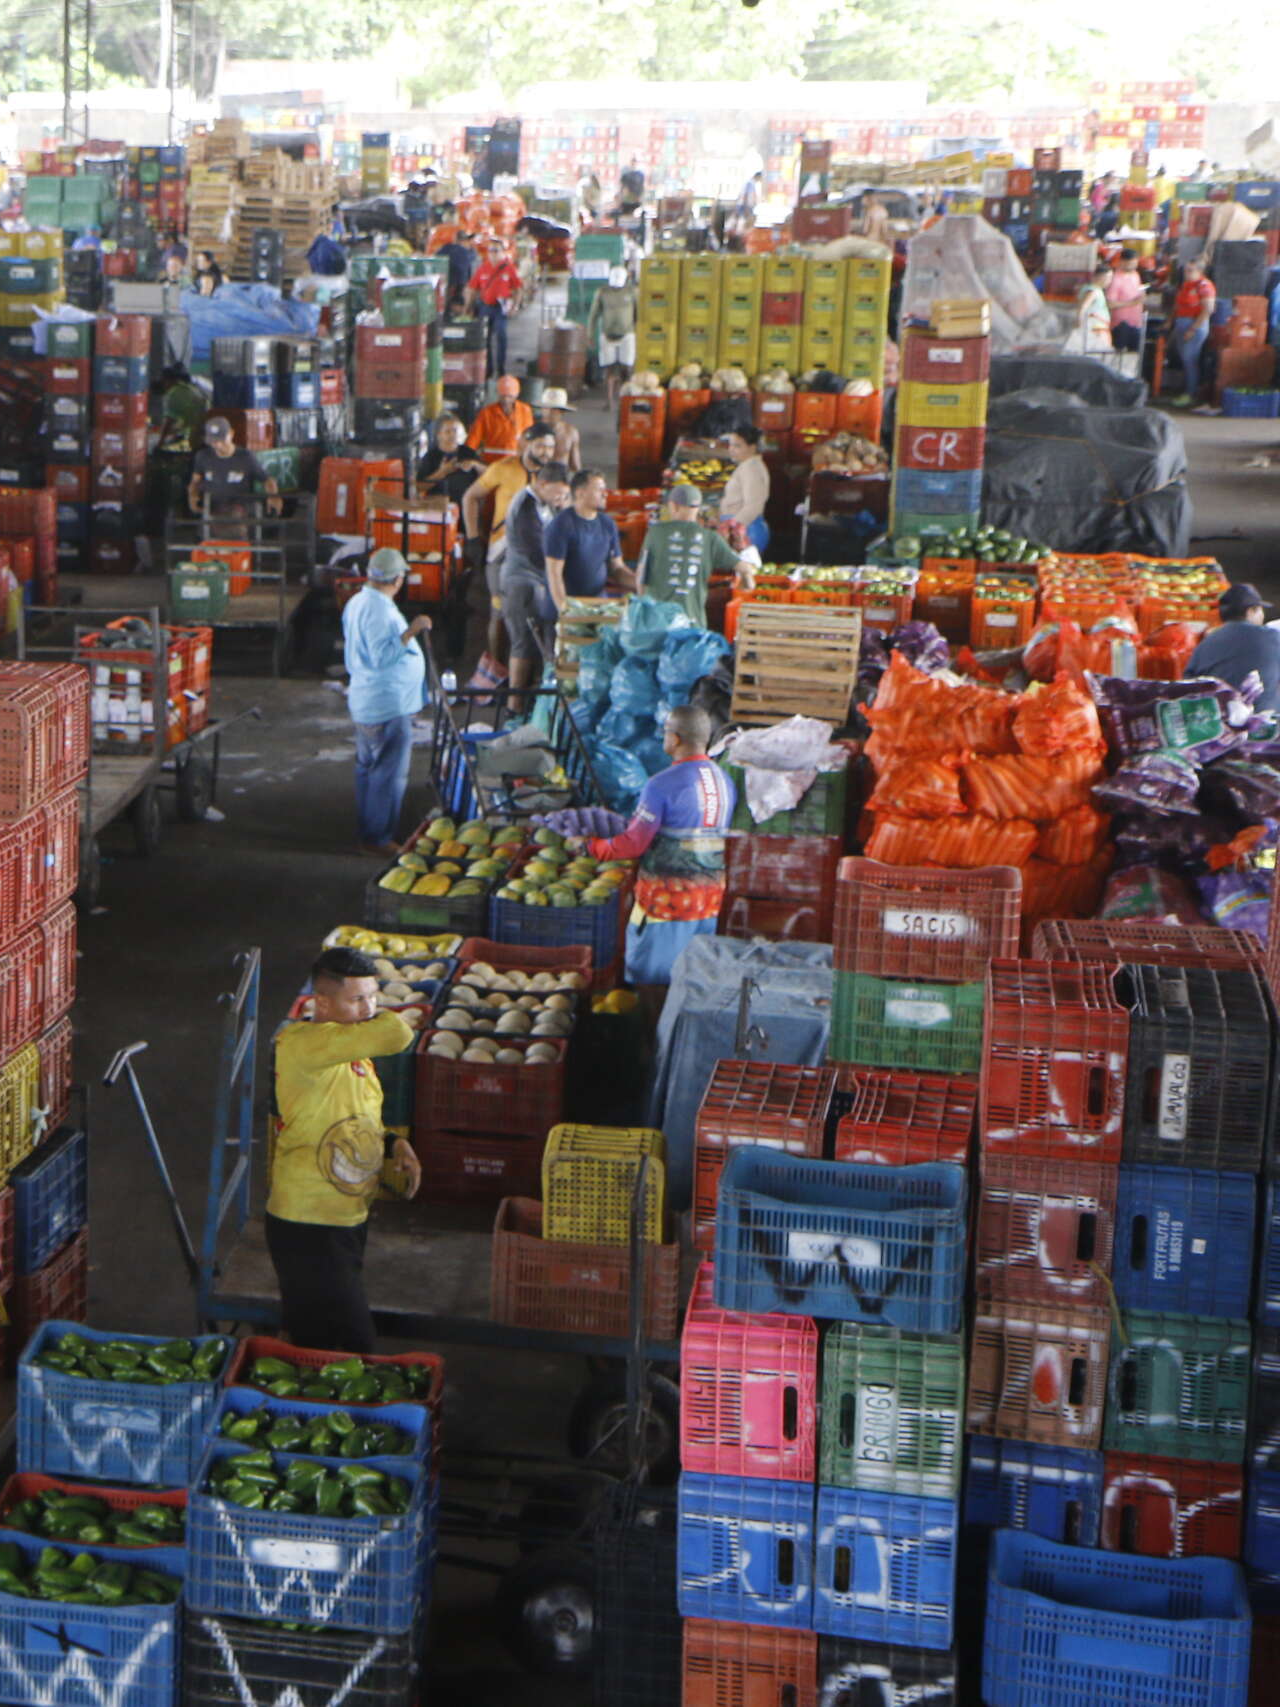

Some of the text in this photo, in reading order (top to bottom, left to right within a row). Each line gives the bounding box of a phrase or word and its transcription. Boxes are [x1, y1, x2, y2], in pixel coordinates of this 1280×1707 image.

[912, 431, 961, 467] CR
[902, 914, 956, 936] SACIS
[858, 1382, 895, 1463] GRINGO
